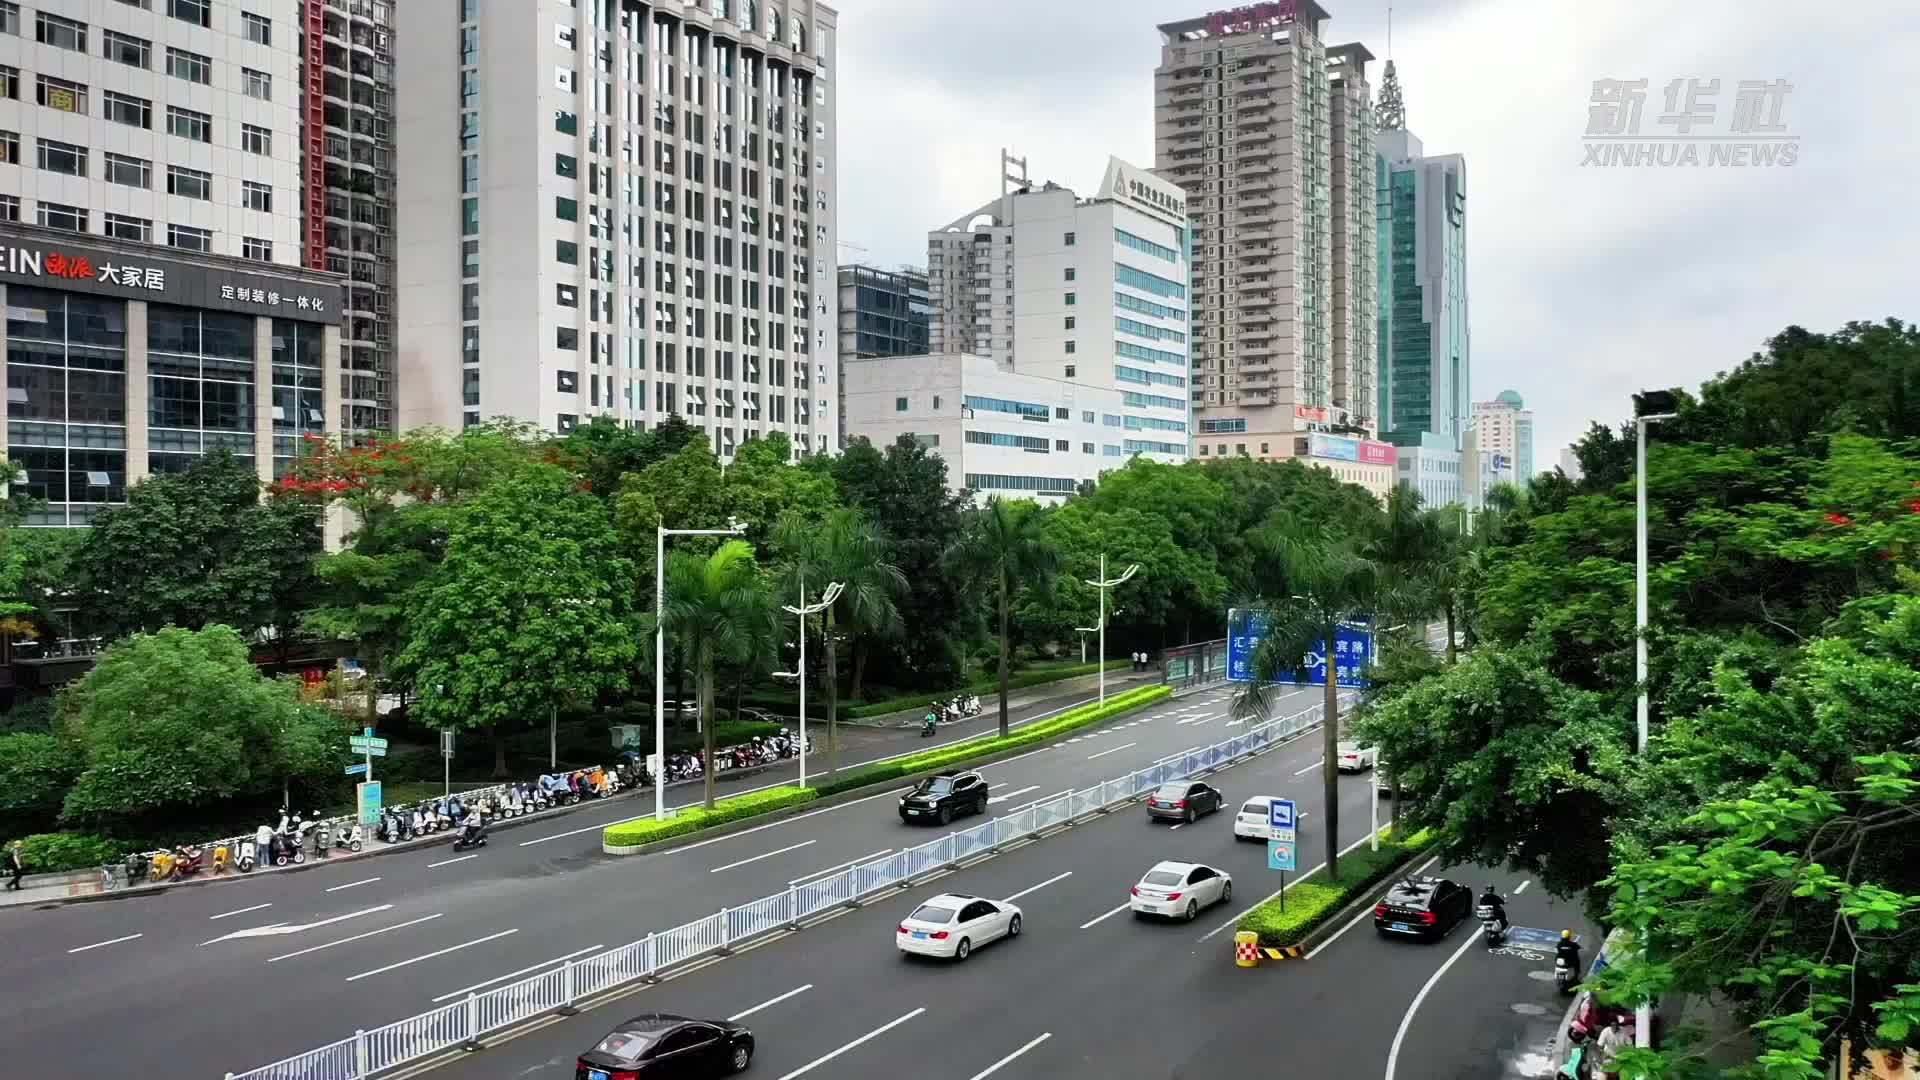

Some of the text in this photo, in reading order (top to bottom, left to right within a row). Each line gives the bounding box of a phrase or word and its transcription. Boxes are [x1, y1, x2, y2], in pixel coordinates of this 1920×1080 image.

[220, 285, 324, 311] 定制装修一体化
